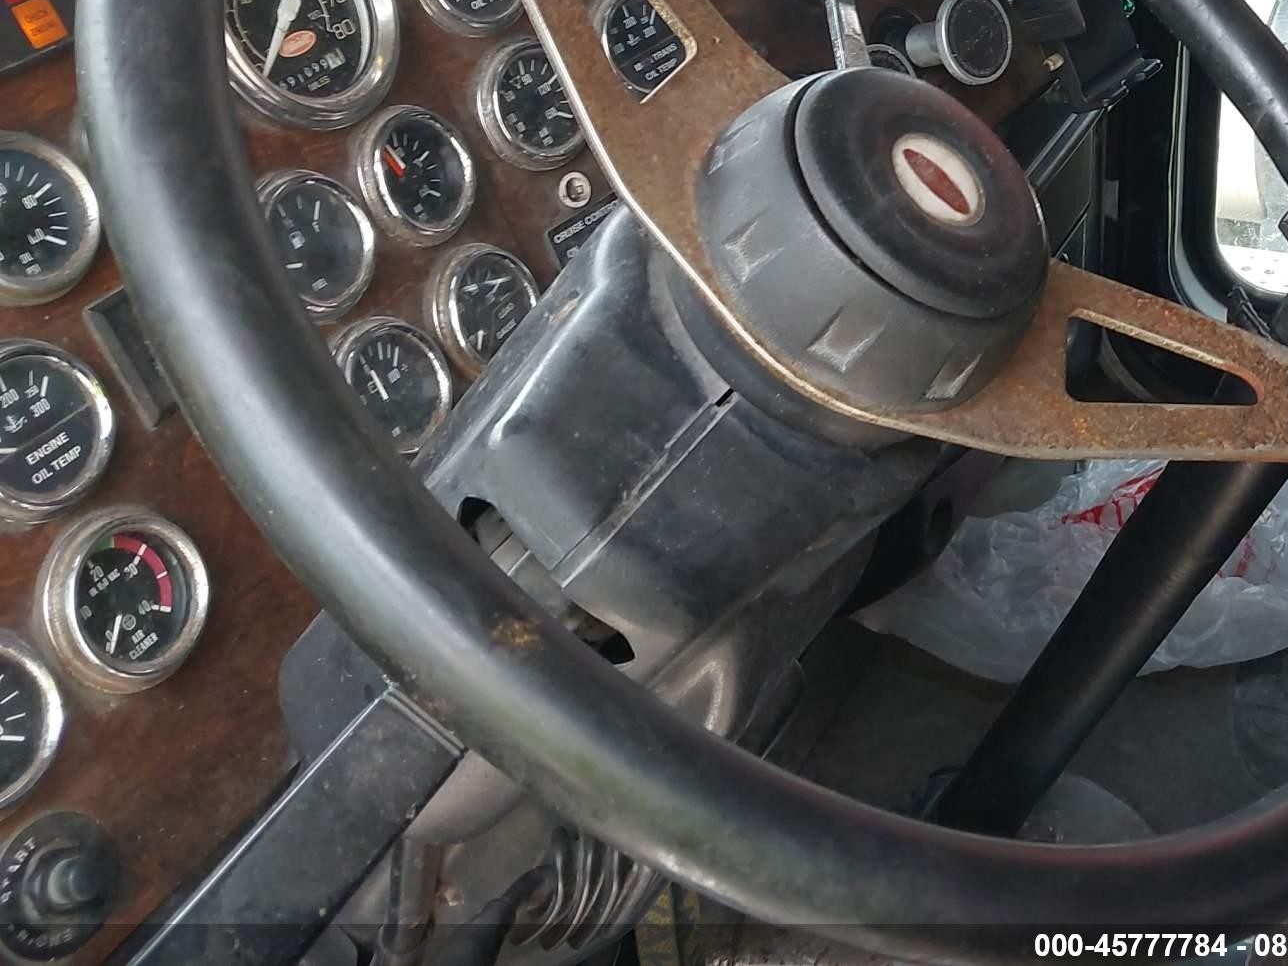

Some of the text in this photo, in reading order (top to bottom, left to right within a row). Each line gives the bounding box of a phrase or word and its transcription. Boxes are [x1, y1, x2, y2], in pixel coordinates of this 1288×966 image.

[332, 18, 356, 40] 80
[553, 199, 618, 244] CRUISE CONTRO
[29, 398, 51, 418] 300
[25, 431, 70, 465] ENGINE
[32, 445, 82, 484] OIL TEMP
[90, 565, 104, 583] 20
[138, 600, 152, 615] 40
[129, 632, 158, 660] CLEANER
[131, 629, 145, 644] AIR
